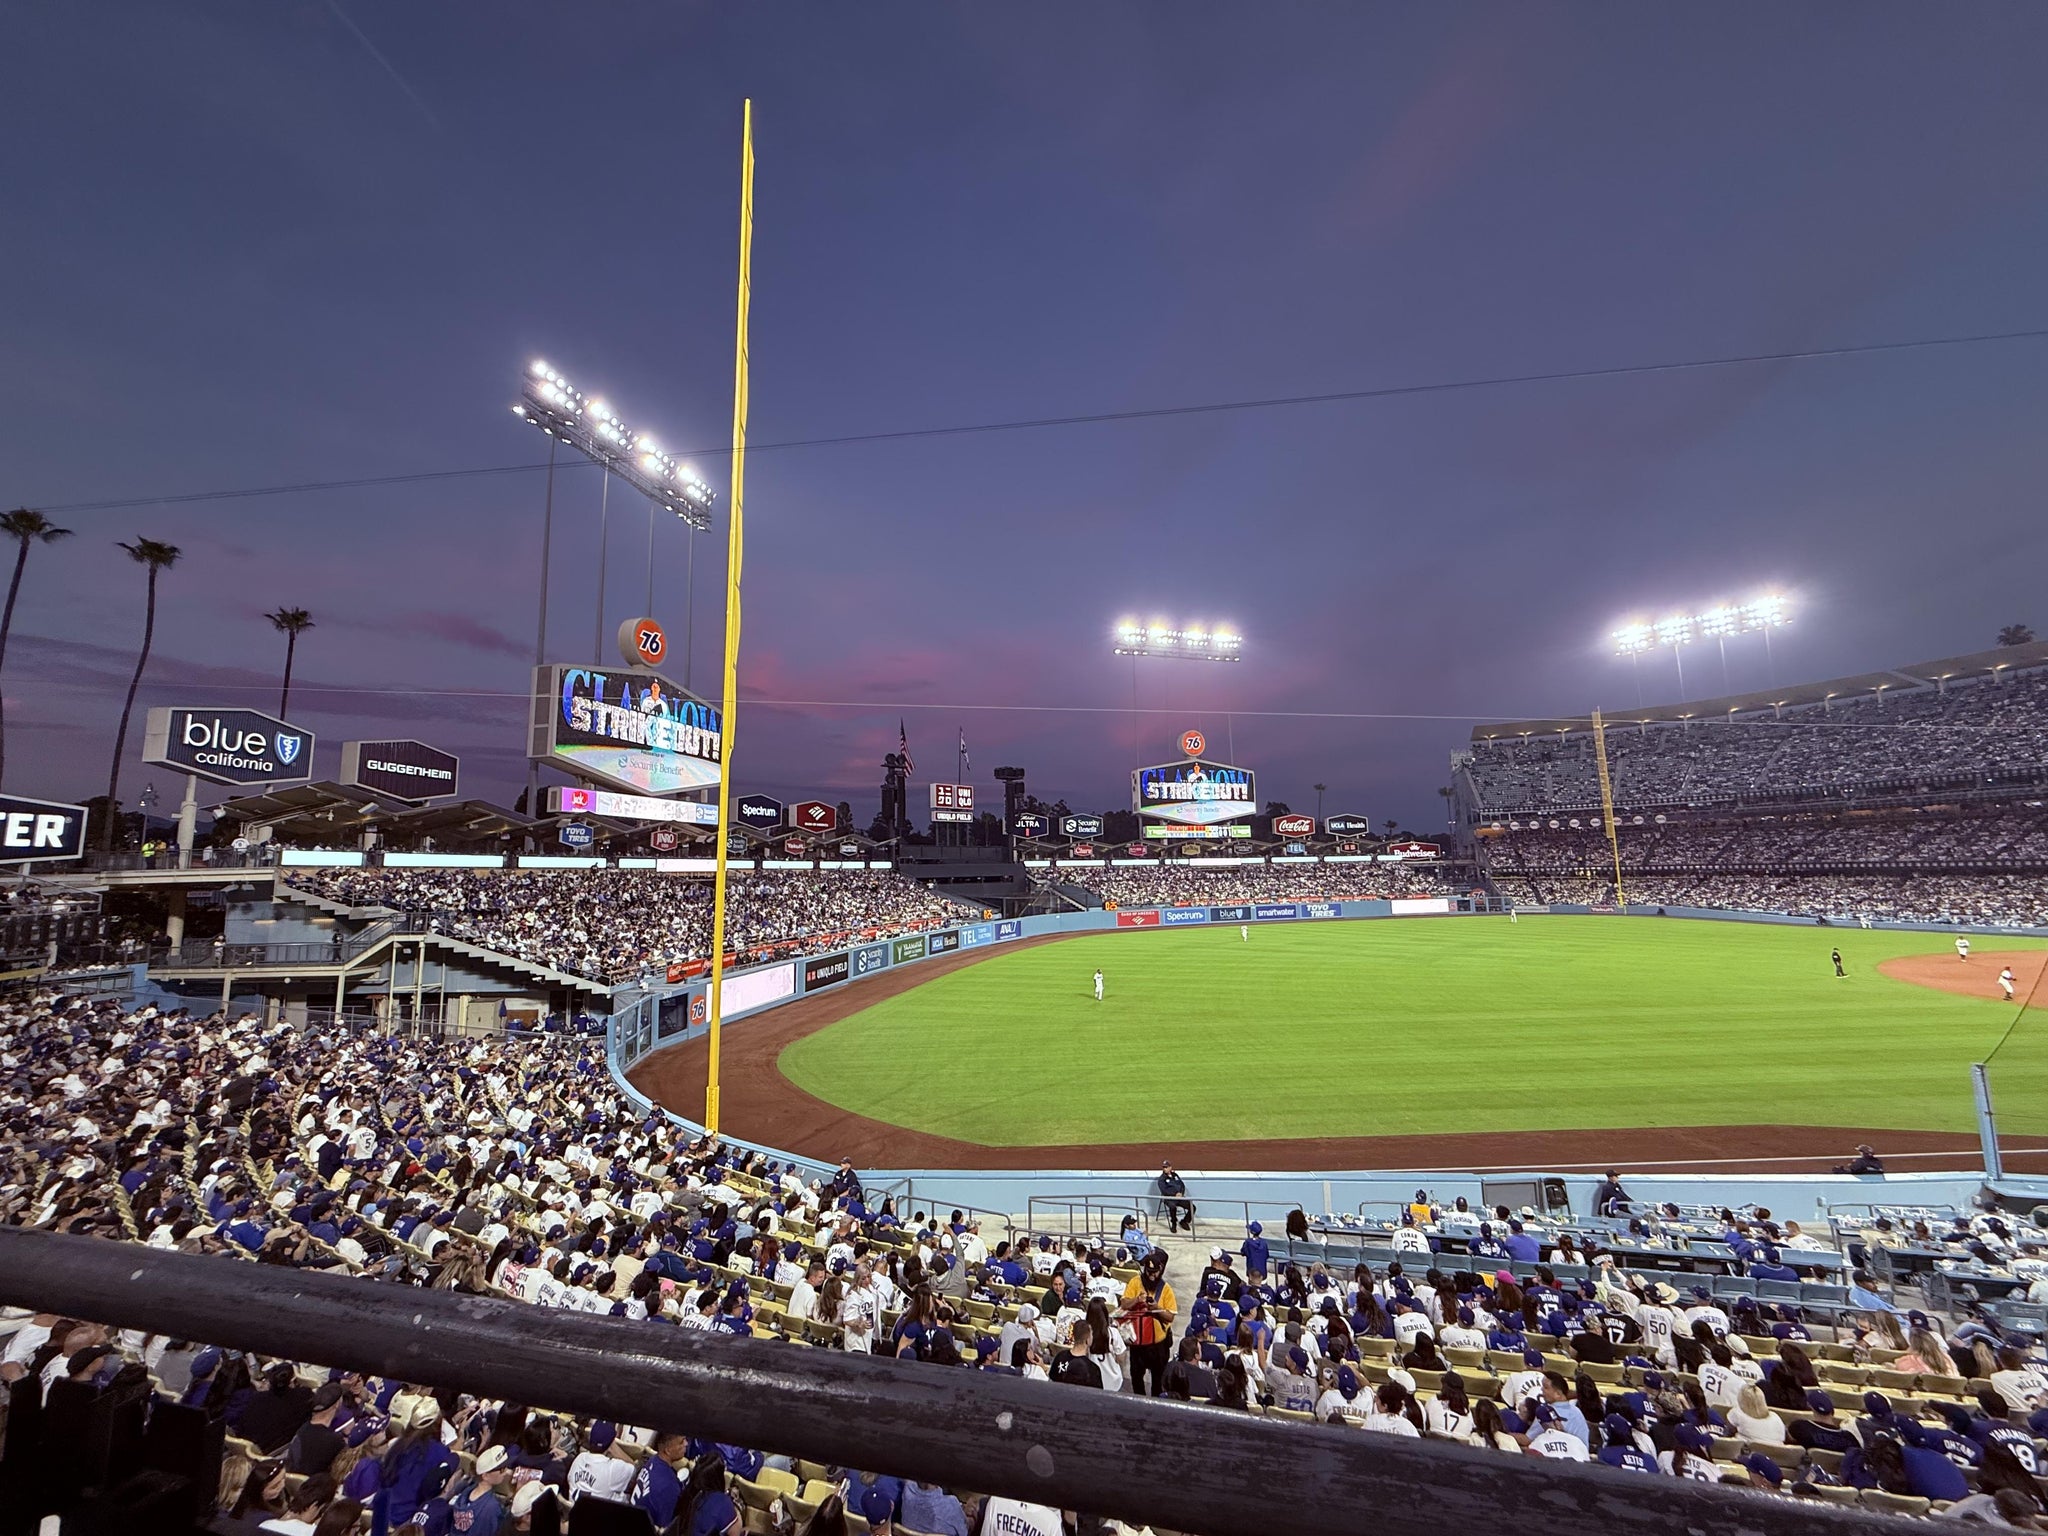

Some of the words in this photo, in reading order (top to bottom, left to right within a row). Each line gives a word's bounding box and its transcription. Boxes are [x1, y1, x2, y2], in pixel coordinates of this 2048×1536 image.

[639, 629, 662, 656] 76
[183, 713, 267, 756] blue
[569, 695, 720, 761] STRIKEOUT!
[1185, 736, 1202, 750] 76
[194, 751, 274, 772] california
[630, 758, 658, 775] Security
[659, 761, 683, 777] Benefit
[366, 759, 453, 781] GUGGENHEIM
[958, 788, 971, 797] UNI
[1147, 781, 1248, 800] STRIKEOUT!
[958, 797, 972, 807] QLO
[742, 803, 776, 818] Spectrum
[936, 813, 956, 821] UNIQLO
[957, 813, 972, 821] FIELD
[0, 811, 66, 848] ER
[1077, 819, 1100, 828] Security
[1278, 819, 1311, 832] Coca-Cola
[565, 827, 586, 835] TOYO
[656, 830, 674, 844] JINRO
[568, 834, 590, 843] TIRES
[1288, 844, 1304, 852] TEL
[1393, 849, 1437, 858] Budweiser
[1473, 893, 1486, 901] 76
[1166, 910, 1200, 922] Spectrum
[1219, 909, 1236, 918] blue
[1257, 908, 1296, 917] smartwater
[1310, 910, 1336, 918] TIRES
[1000, 924, 1012, 934] ANA
[931, 939, 943, 949] UCLA
[944, 935, 958, 946] Health
[962, 929, 977, 945] TEL
[867, 948, 883, 959] Security
[867, 957, 882, 968] Benefit
[816, 965, 834, 980] UNIQLO
[834, 960, 848, 974] FIELD
[691, 998, 705, 1019] 76
[365, 1138, 371, 1149] 5
[1453, 1217, 1473, 1225] KERSHAW
[1402, 1240, 1419, 1253] 25
[729, 1260, 739, 1270] 17
[518, 1271, 529, 1282] ETTS
[541, 1282, 556, 1299] ERSHAW
[562, 1290, 578, 1306] ERSHAW
[1603, 1317, 1627, 1330] OHTANI
[1650, 1313, 1665, 1322] BETTS
[1402, 1322, 1428, 1333] BERNAL
[1649, 1320, 1668, 1336] 50
[1607, 1327, 1626, 1344] 17
[1732, 1369, 1759, 1381] OHTANI
[1292, 1384, 1311, 1395] BETTS
[1705, 1375, 1723, 1396] 21
[1443, 1412, 1460, 1433] 17
[1988, 1427, 2035, 1447] YAMAMOTO
[1543, 1440, 1568, 1453] BETTS
[1943, 1439, 1976, 1459] OHTANI
[1622, 1454, 1645, 1467] BETTS
[574, 1470, 597, 1488] OHTANI
